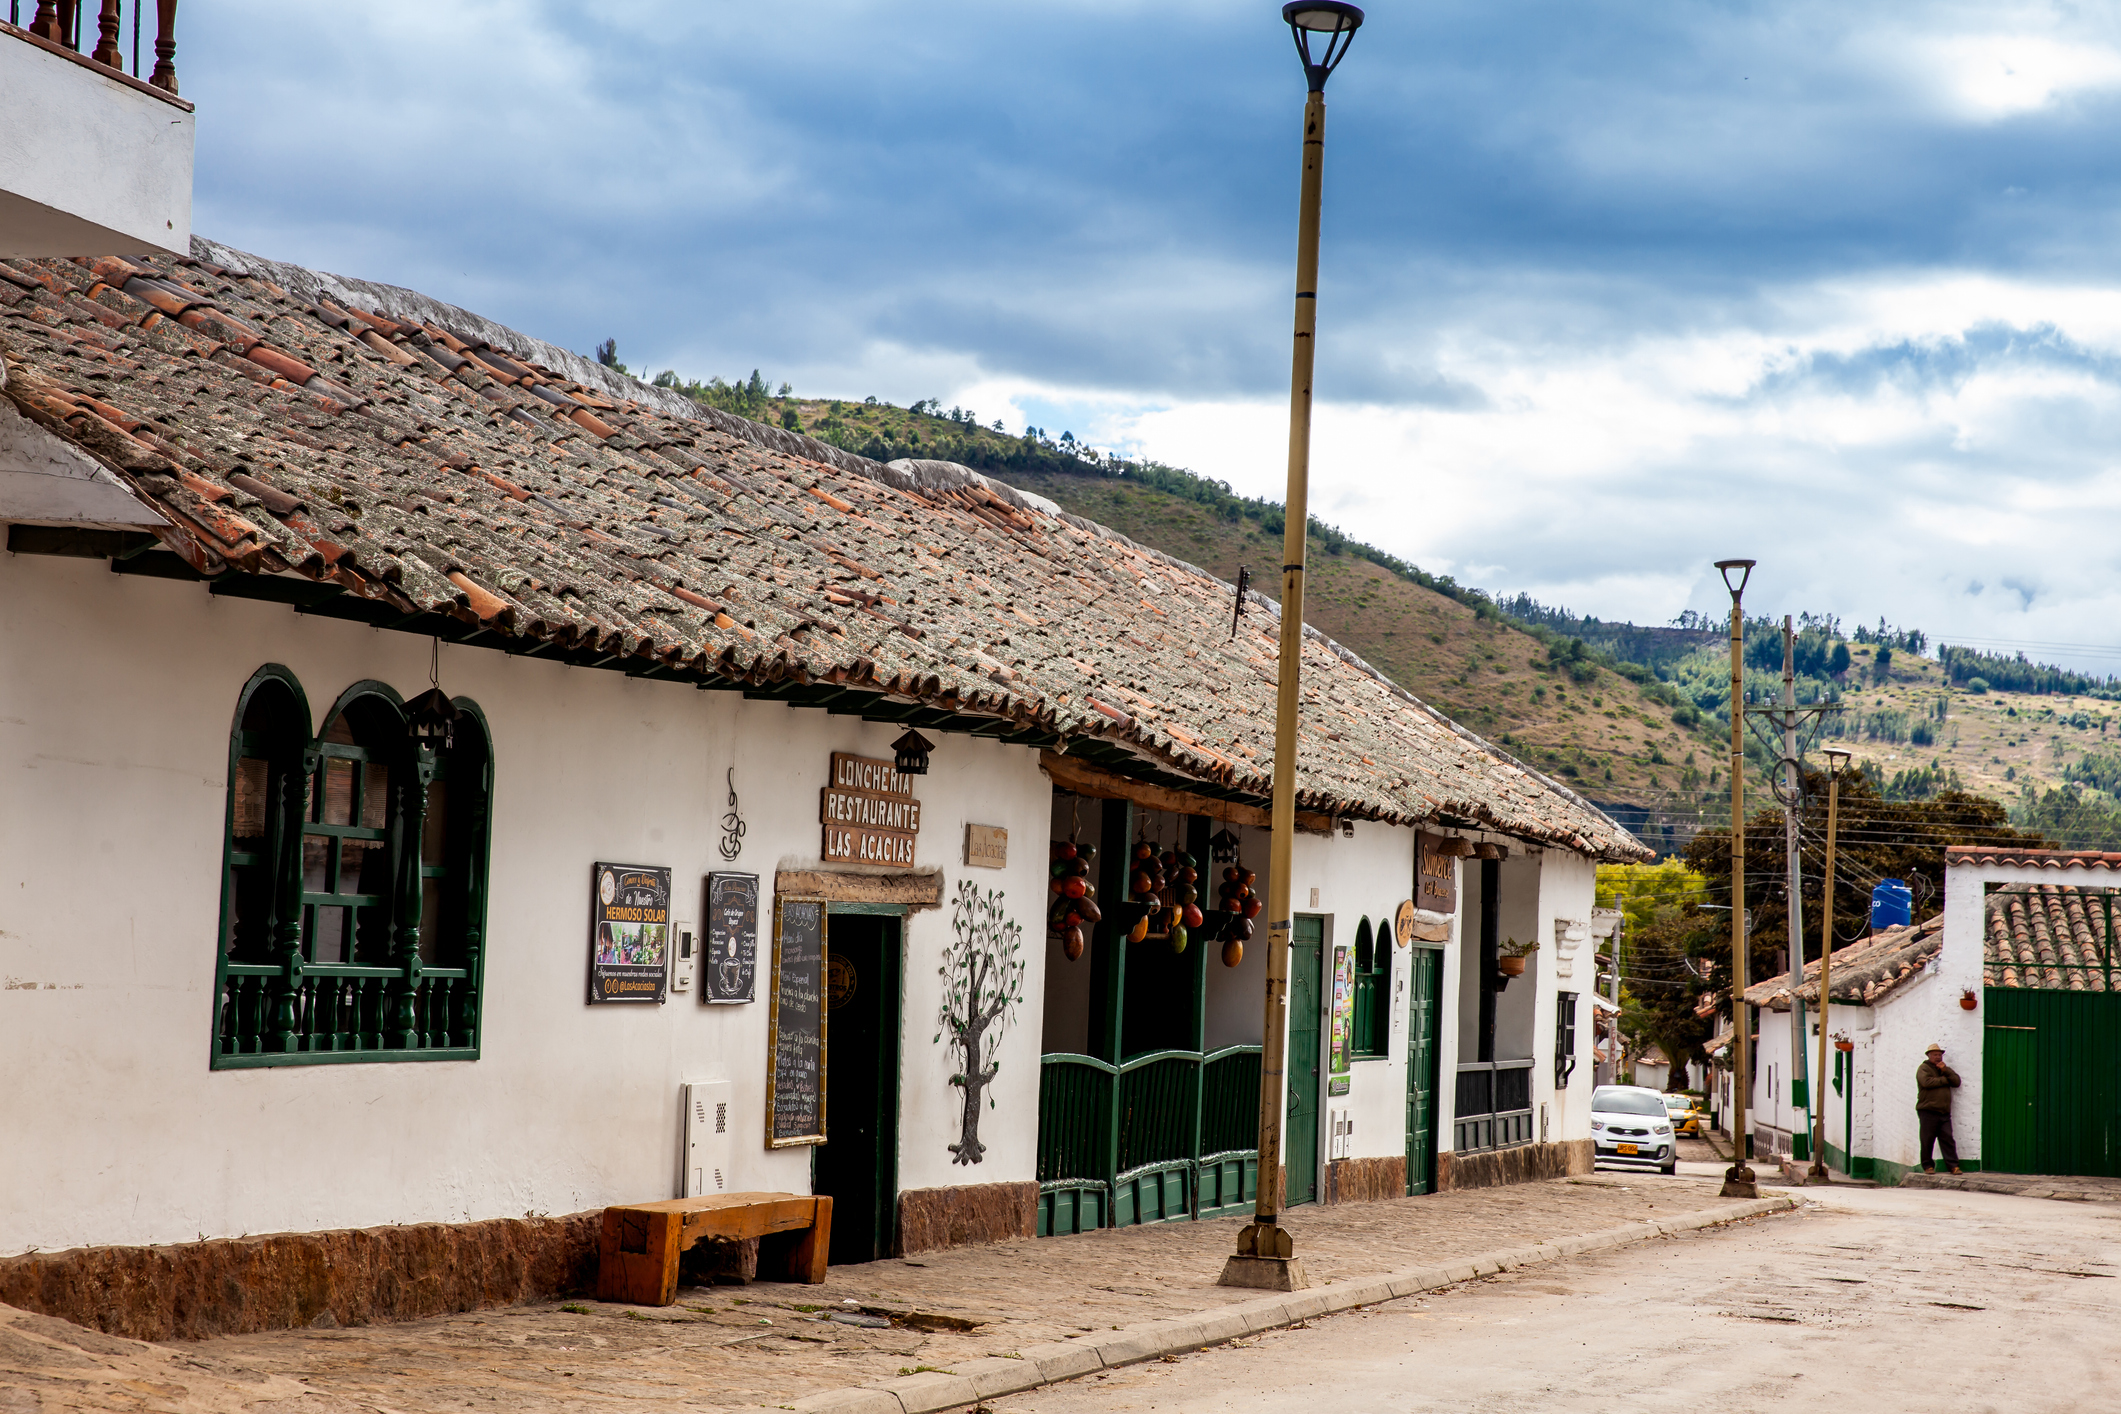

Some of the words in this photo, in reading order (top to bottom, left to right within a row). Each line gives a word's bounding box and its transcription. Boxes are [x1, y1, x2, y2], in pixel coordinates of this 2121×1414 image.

[827, 793, 919, 830] RESTAURANTE
[828, 830, 851, 857] LAS
[859, 834, 913, 863] ACACIAS
[971, 832, 982, 857] Las
[982, 833, 1007, 860] Acacias
[625, 893, 633, 905] de
[633, 890, 654, 906] Nuestro
[606, 906, 643, 922] HERMOSO
[643, 908, 666, 923] SOLAR
